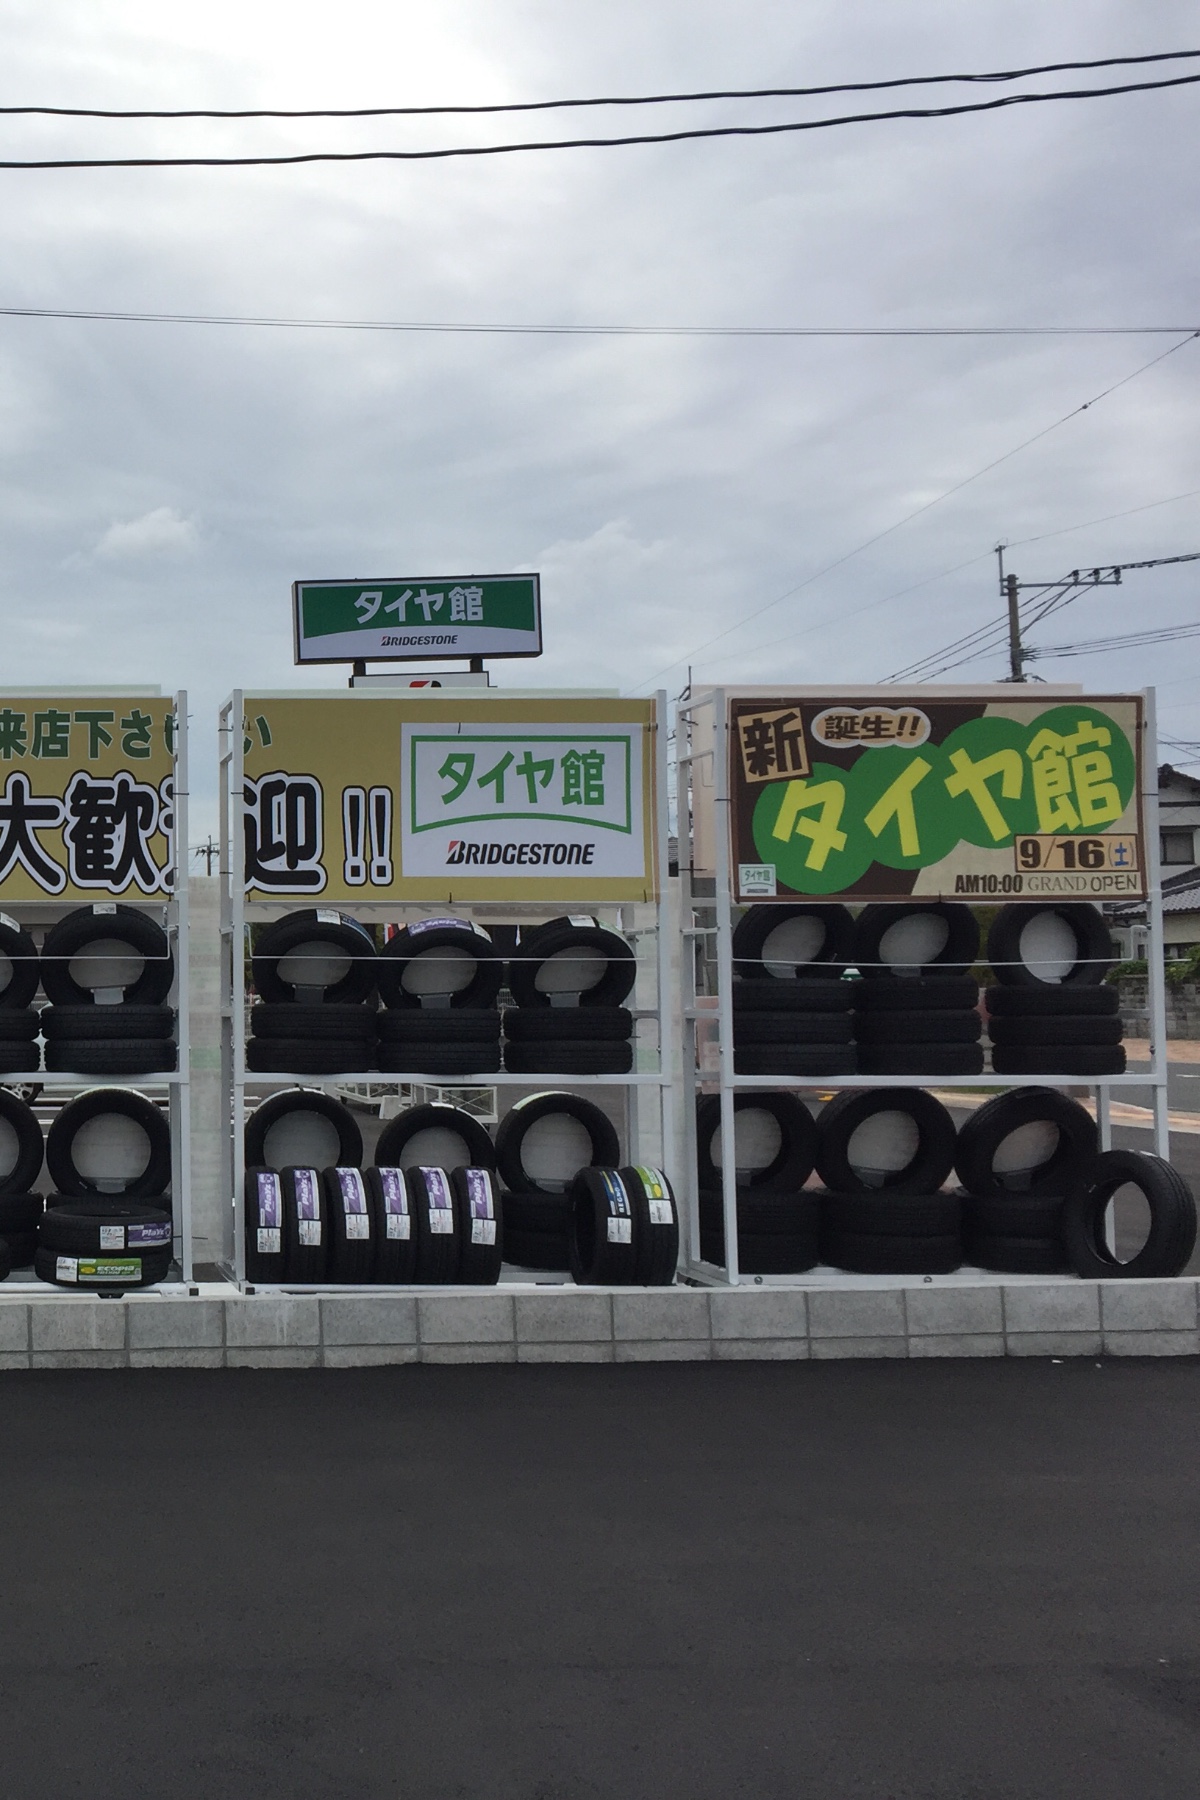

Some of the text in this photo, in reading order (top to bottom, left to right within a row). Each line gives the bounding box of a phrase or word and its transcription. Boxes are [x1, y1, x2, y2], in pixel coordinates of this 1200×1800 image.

[353, 586, 484, 624] タイヤ館
[380, 634, 458, 647] BRIDGESTONE
[823, 714, 920, 740] 誕生!!
[743, 711, 802, 776] 新
[437, 748, 606, 806] タイヤ館
[772, 720, 1123, 872] タイヤ館
[445, 840, 596, 866] BRIDGESTONE
[1019, 837, 1136, 868] 9/16(土)
[954, 874, 1138, 893] AM10:00 GRAND OPEN
